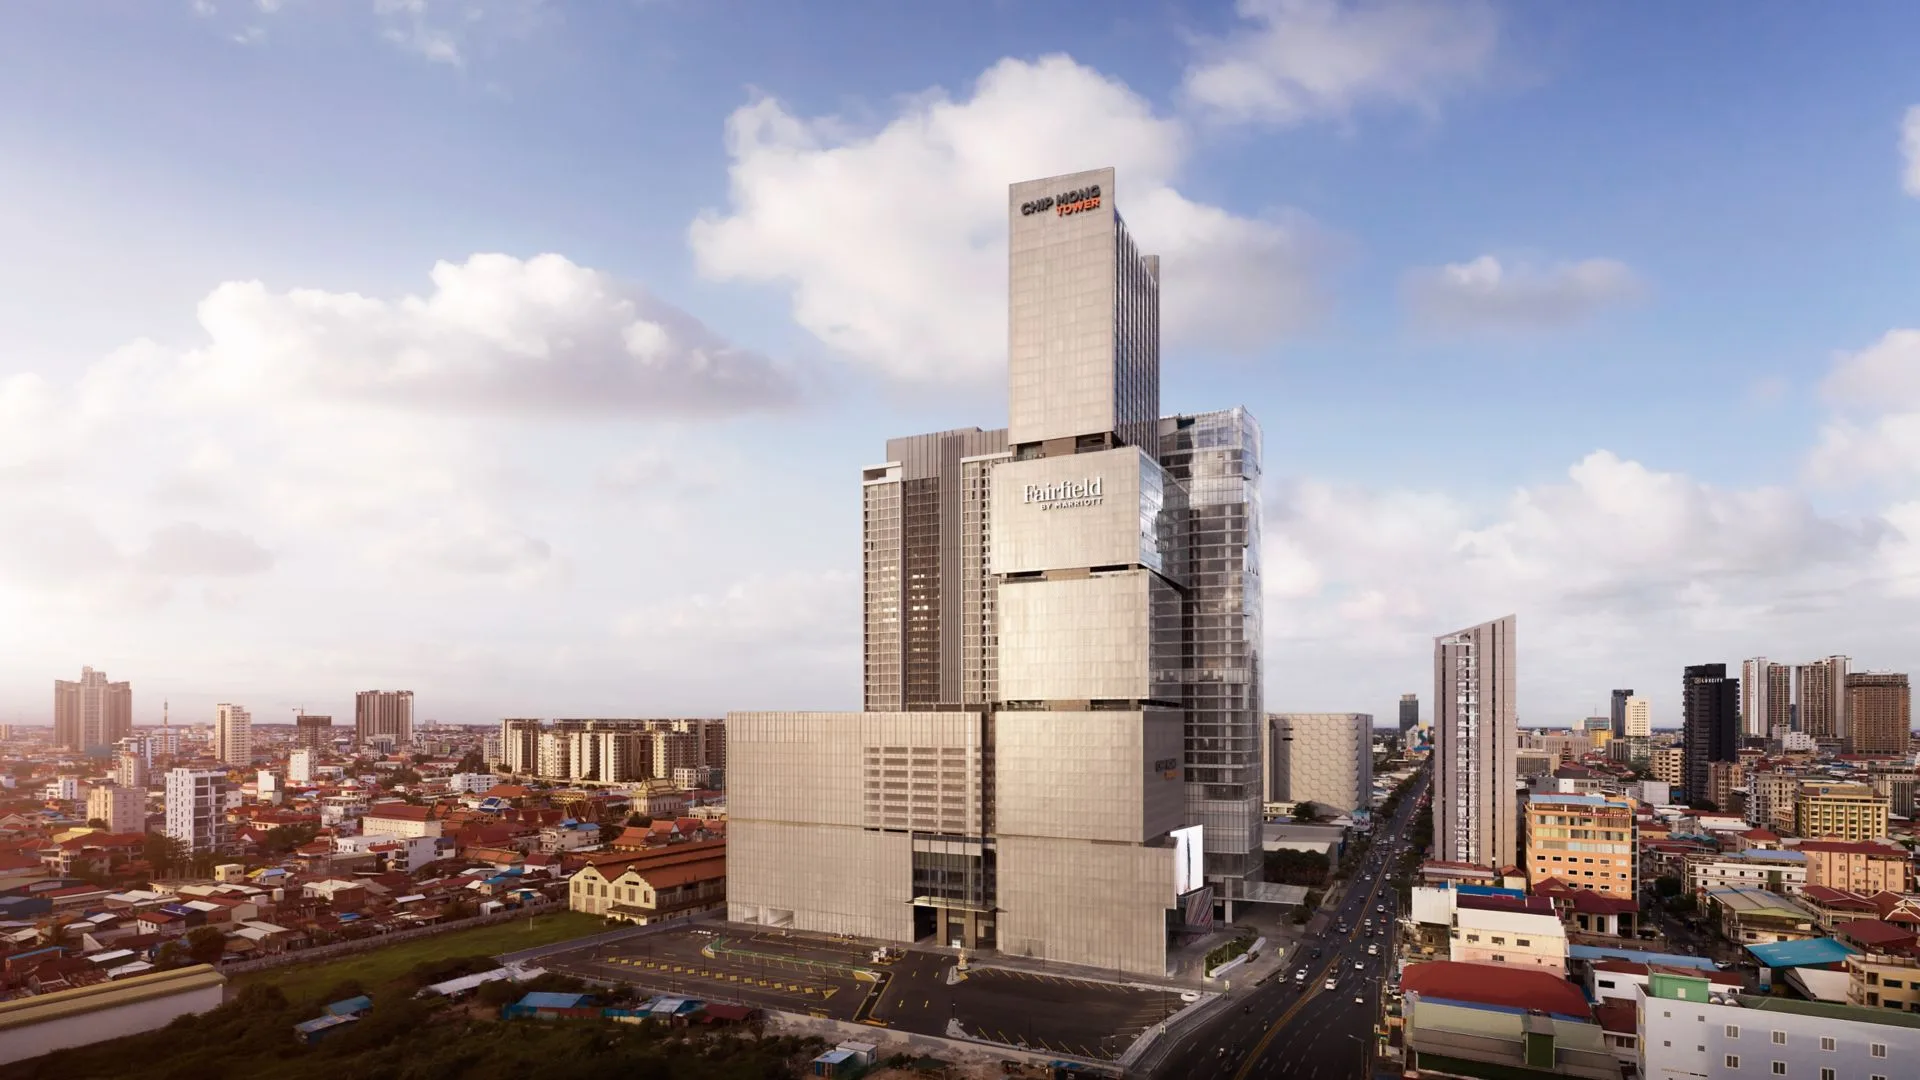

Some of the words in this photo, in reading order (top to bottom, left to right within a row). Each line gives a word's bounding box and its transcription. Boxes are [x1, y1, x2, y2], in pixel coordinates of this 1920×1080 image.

[1021, 196, 1054, 216] CHIP
[1056, 185, 1101, 207] MONG
[1056, 198, 1101, 217] TOWER
[1024, 476, 1103, 504] Fairfield
[1041, 503, 1053, 511] BY
[1055, 499, 1103, 510] MARRIOTT
